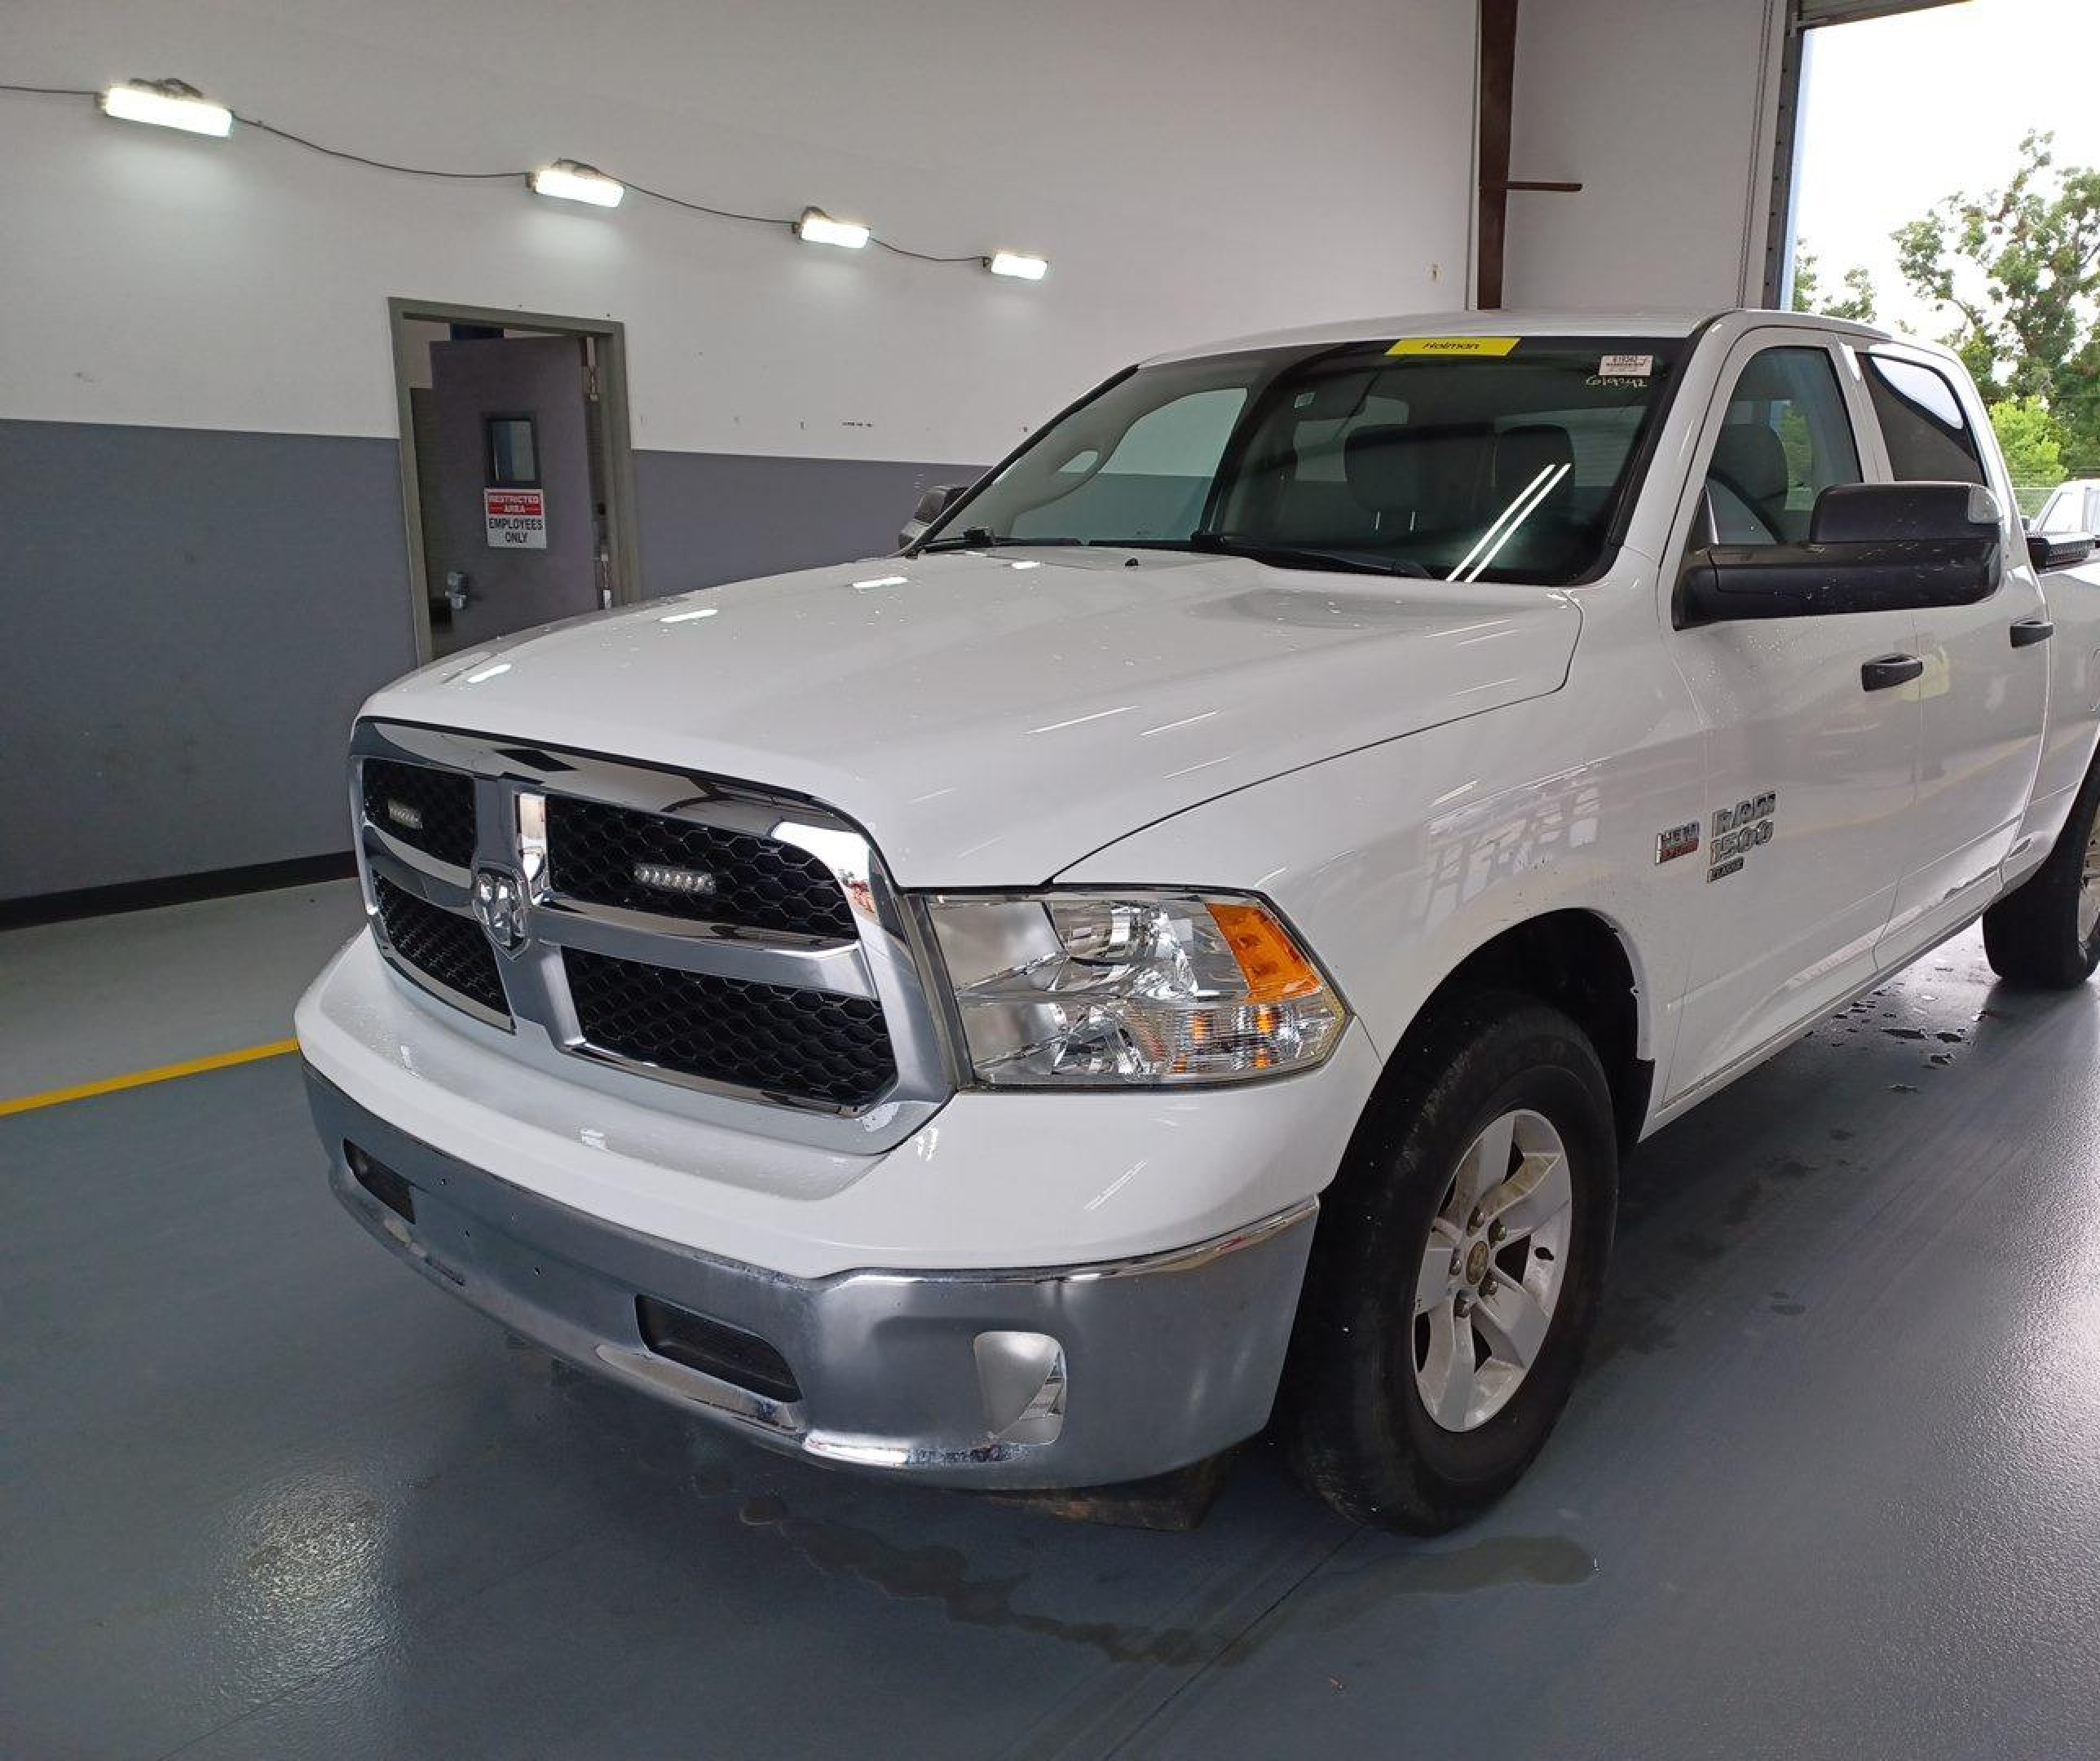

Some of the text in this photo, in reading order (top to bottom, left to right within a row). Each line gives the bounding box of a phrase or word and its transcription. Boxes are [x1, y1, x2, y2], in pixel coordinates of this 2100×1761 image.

[1422, 342, 1480, 350] Holman
[488, 495, 540, 503] RESTRICTED
[504, 505, 526, 513] AREA
[489, 518, 543, 530] EMPLOYEES
[505, 532, 528, 544] ONLY
[1712, 791, 1776, 838] RAM
[1710, 820, 1773, 866] 1500
